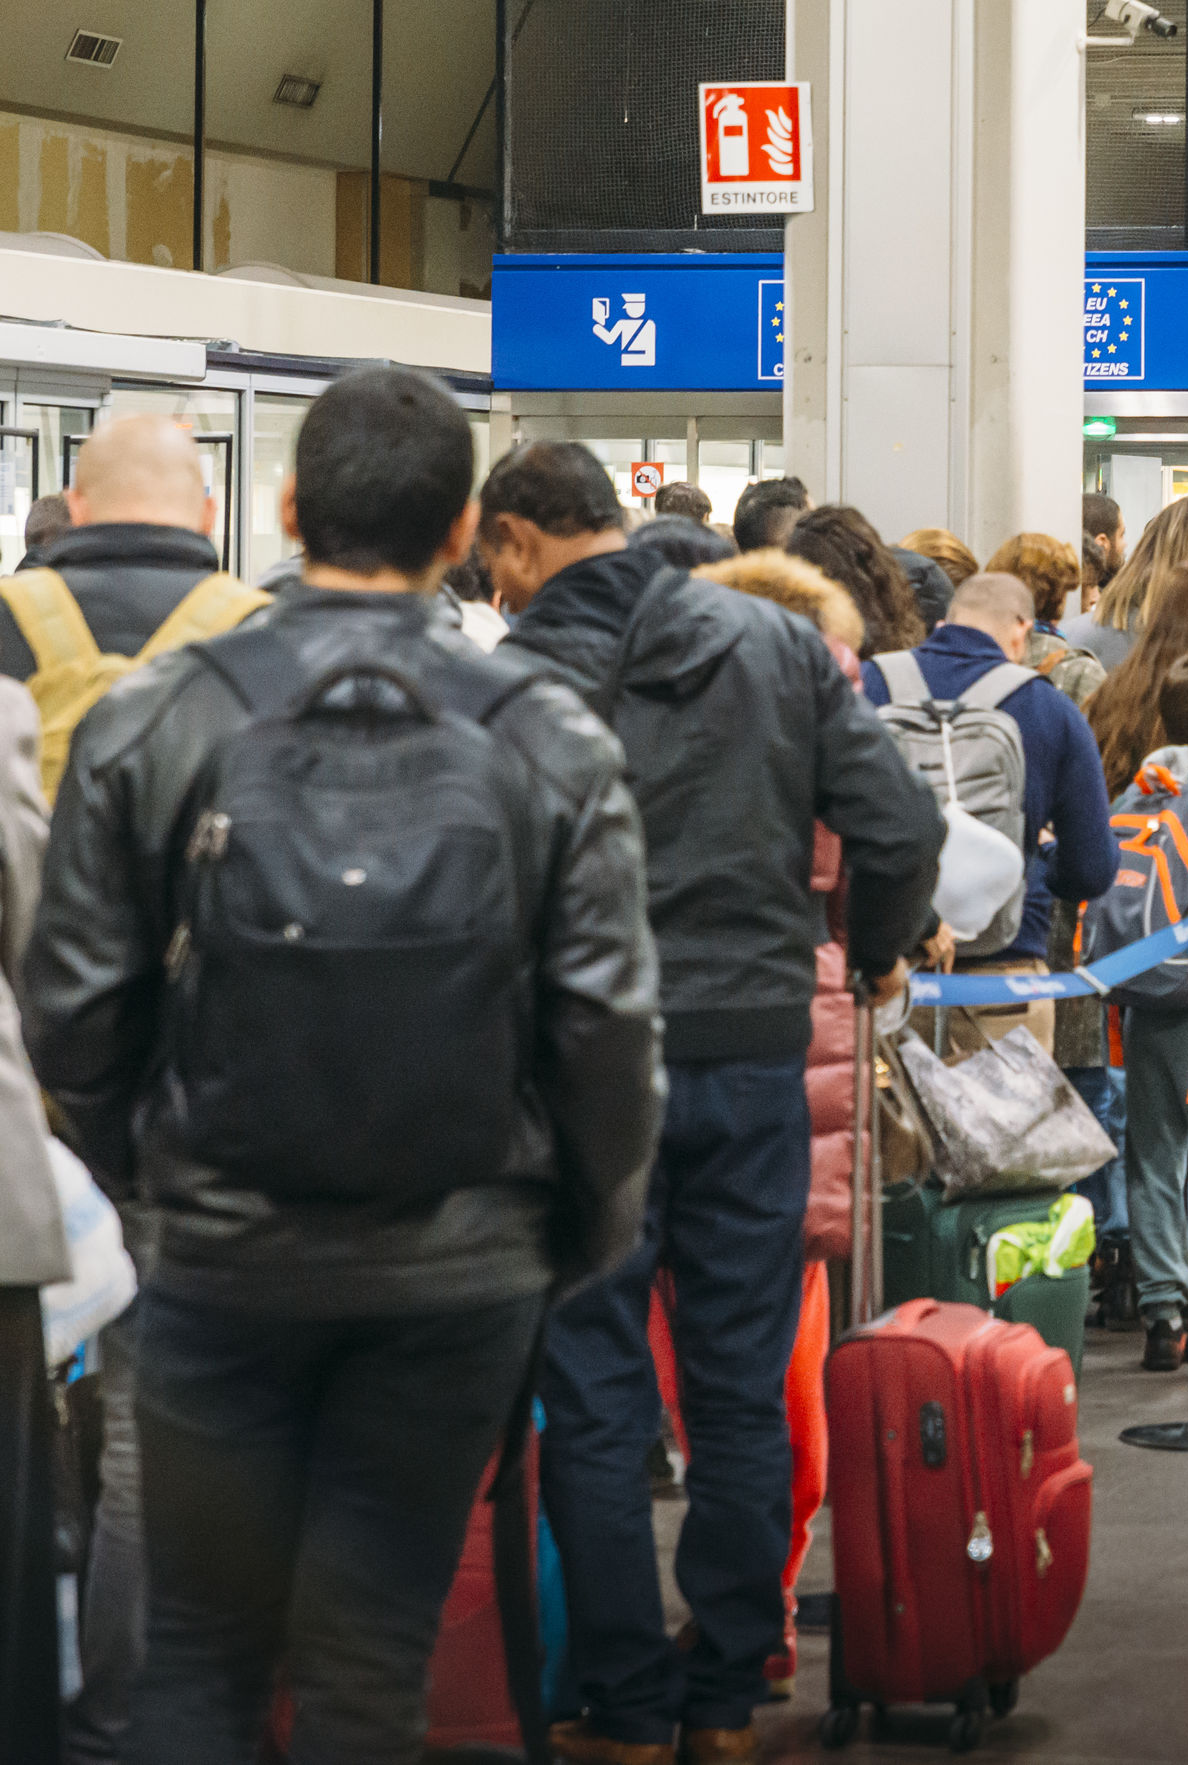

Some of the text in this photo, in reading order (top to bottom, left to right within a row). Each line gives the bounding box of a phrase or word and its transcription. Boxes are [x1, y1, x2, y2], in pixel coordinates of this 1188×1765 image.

[711, 191, 798, 205] ESTINTORE
[1086, 297, 1108, 310] EU
[1083, 313, 1111, 327] EEA
[1086, 329, 1109, 343] CH
